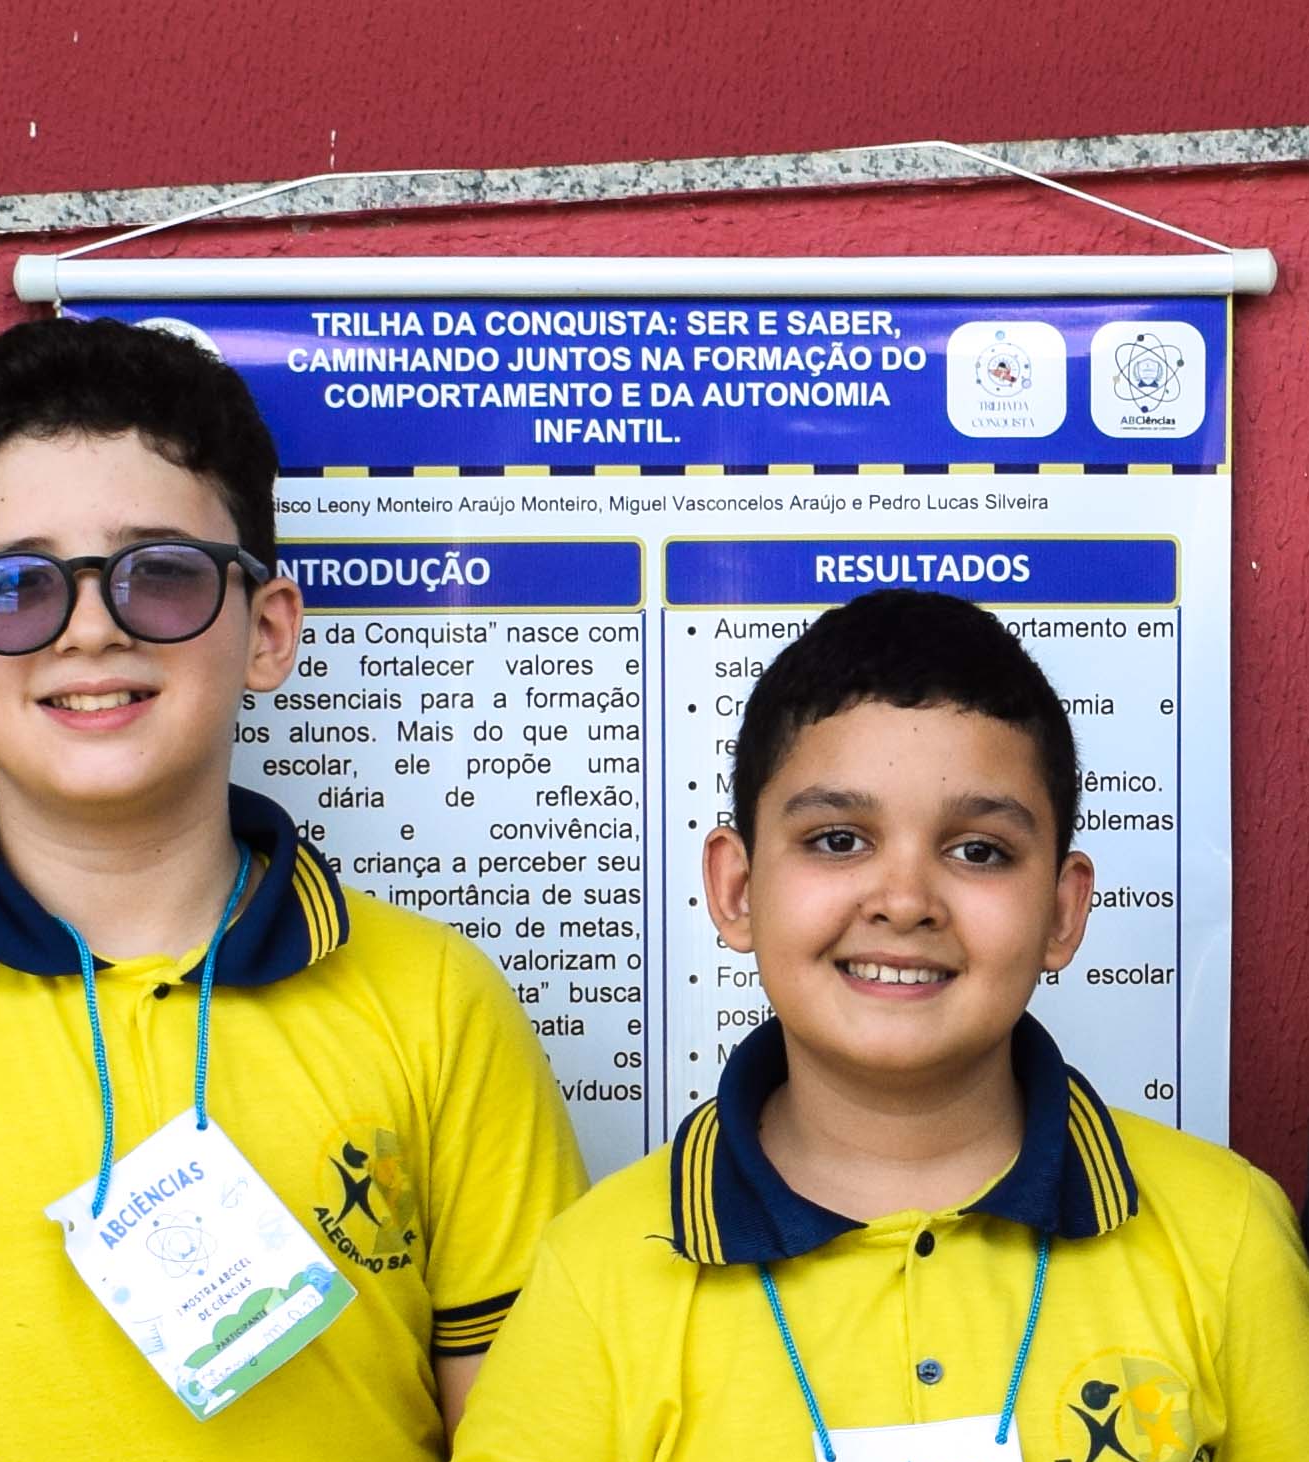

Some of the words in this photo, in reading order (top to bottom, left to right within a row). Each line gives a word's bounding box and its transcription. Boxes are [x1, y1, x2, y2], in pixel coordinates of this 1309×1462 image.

[311, 311, 424, 337] TRILHA
[432, 311, 477, 336] DA
[484, 310, 677, 338] CONQUISTA:
[686, 310, 749, 336] SER
[758, 310, 778, 336] E
[786, 310, 902, 340] SABER,
[287, 347, 500, 374] CAMINHANDO
[507, 346, 632, 373] JUNTOS
[641, 346, 685, 372] NA
[693, 341, 873, 377] FORMAÇÃO
[881, 345, 927, 372] DO
[324, 382, 613, 410] COMPORTAMENTO
[621, 382, 642, 408] E
[650, 382, 695, 408] DA
[701, 382, 892, 409] AUTONOMIA
[533, 417, 682, 444] INFANTIL.
[275, 496, 312, 514] isco
[317, 496, 371, 516] Leony
[377, 496, 453, 514] Monteiro
[458, 495, 515, 516] Araújo
[521, 495, 603, 515] Monteiro,
[608, 495, 667, 516] Miguel
[672, 495, 784, 512] Vasconcelos
[790, 494, 846, 515] Araújo
[852, 500, 863, 511] e
[869, 494, 921, 511] Pedro
[927, 494, 979, 511] Lucas
[985, 493, 1049, 511] Silveira
[815, 554, 1031, 584] RESULTADOS
[325, 622, 356, 645] da
[506, 625, 580, 644] nasce
[588, 625, 640, 643] com
[714, 618, 809, 639] Aument
[1006, 617, 1127, 639] ortamento
[1137, 621, 1175, 639] em
[298, 655, 328, 677] de
[359, 654, 475, 677] fortalecer
[505, 654, 594, 676] valores
[625, 658, 641, 676] e
[715, 656, 764, 678] sala
[273, 687, 403, 711] essenciais
[420, 693, 475, 715] para
[492, 692, 508, 709] a
[525, 686, 640, 714] formação
[1159, 698, 1175, 715] e
[289, 720, 377, 743] alunos.
[397, 719, 454, 742] Mais
[473, 719, 503, 742] do
[522, 724, 568, 747] que
[587, 724, 641, 742] uma
[262, 754, 358, 779] escolar,
[394, 753, 431, 775] ele
[466, 753, 551, 780] propõe
[587, 757, 641, 774] uma
[317, 786, 385, 809] diária
[444, 786, 475, 808] de
[535, 785, 641, 811] reflexão,
[399, 824, 415, 841] e
[488, 817, 641, 843] convivência,
[353, 852, 442, 879] criança
[452, 856, 467, 874] a
[478, 852, 588, 878] perceber
[596, 855, 641, 873] seu
[388, 883, 531, 911] importância
[541, 883, 573, 906] de
[583, 888, 642, 905] suas
[515, 917, 546, 938] de
[559, 917, 641, 941] metas,
[499, 949, 617, 971] valorizam
[626, 954, 642, 971] o
[1085, 963, 1176, 986] escolar
[569, 981, 642, 1004] busca
[627, 1018, 642, 1036] e
[716, 1004, 775, 1032] posit
[612, 1051, 643, 1069] os
[1143, 1078, 1175, 1101] do
[98, 1161, 205, 1250] ABCIÊNCIAS
[181, 1283, 218, 1314] MOSTRA
[197, 1306, 212, 1322] DE
[211, 1276, 253, 1312] CIÊNCIAS
